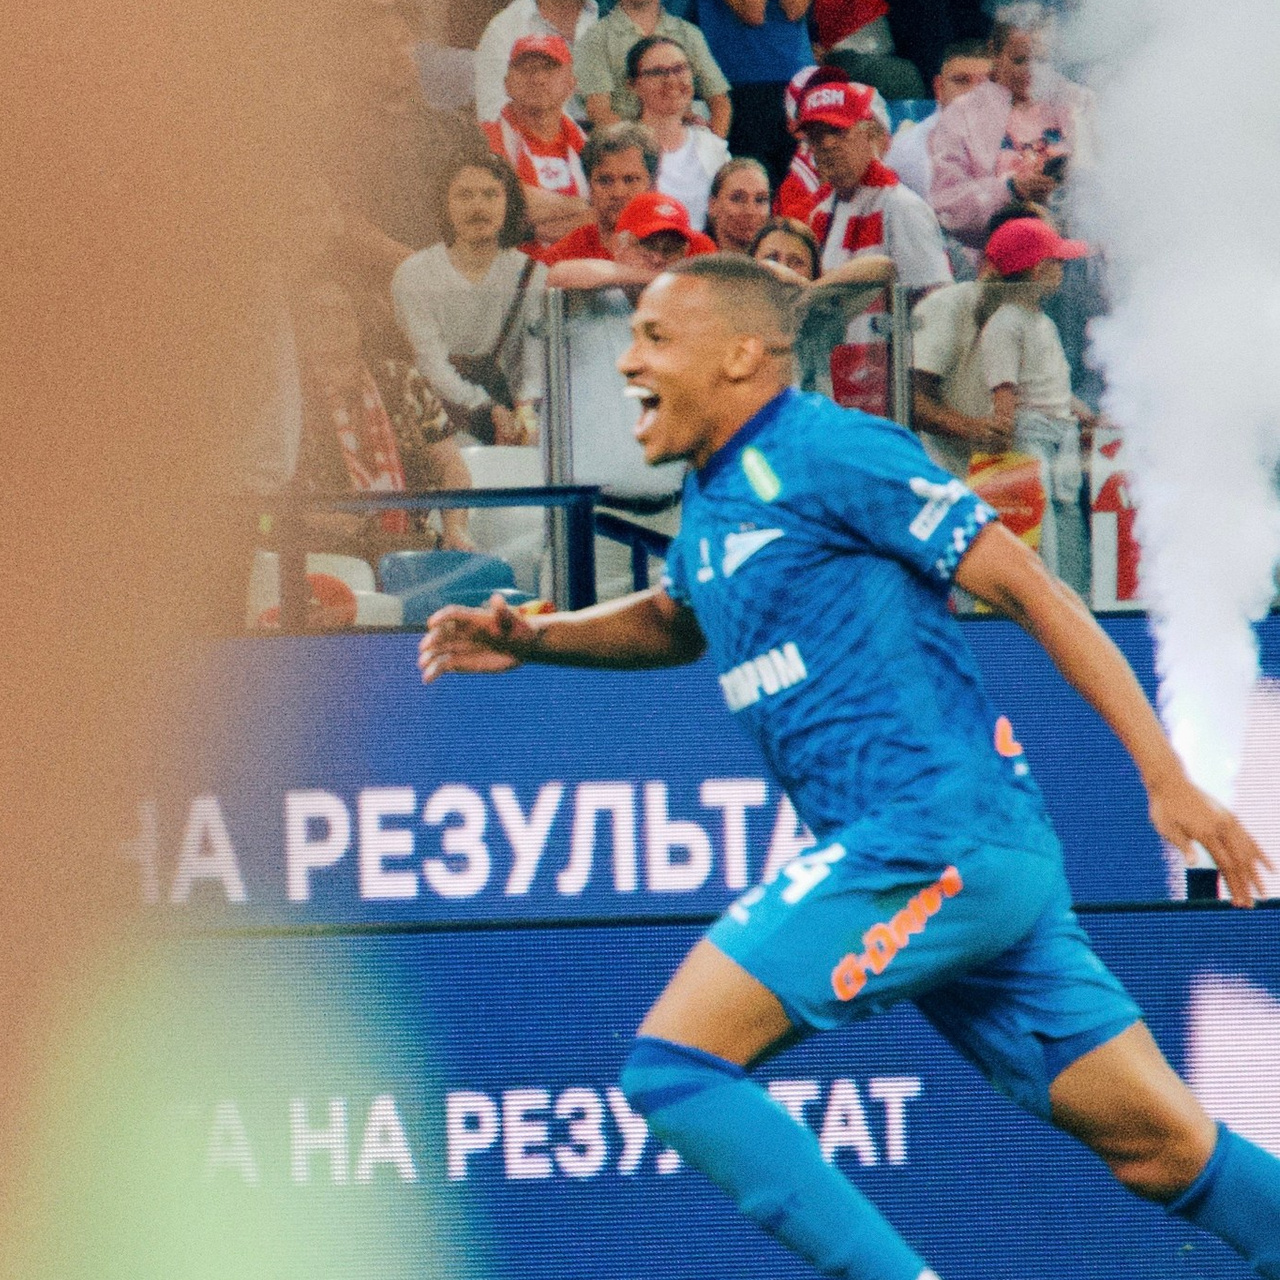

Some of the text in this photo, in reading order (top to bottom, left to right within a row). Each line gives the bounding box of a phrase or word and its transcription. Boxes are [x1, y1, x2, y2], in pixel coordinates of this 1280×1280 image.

[283, 777, 819, 904] РЕЗУЛЬТА
[289, 1092, 418, 1187] НА
[445, 1075, 923, 1184] РЕЗУТАТ
